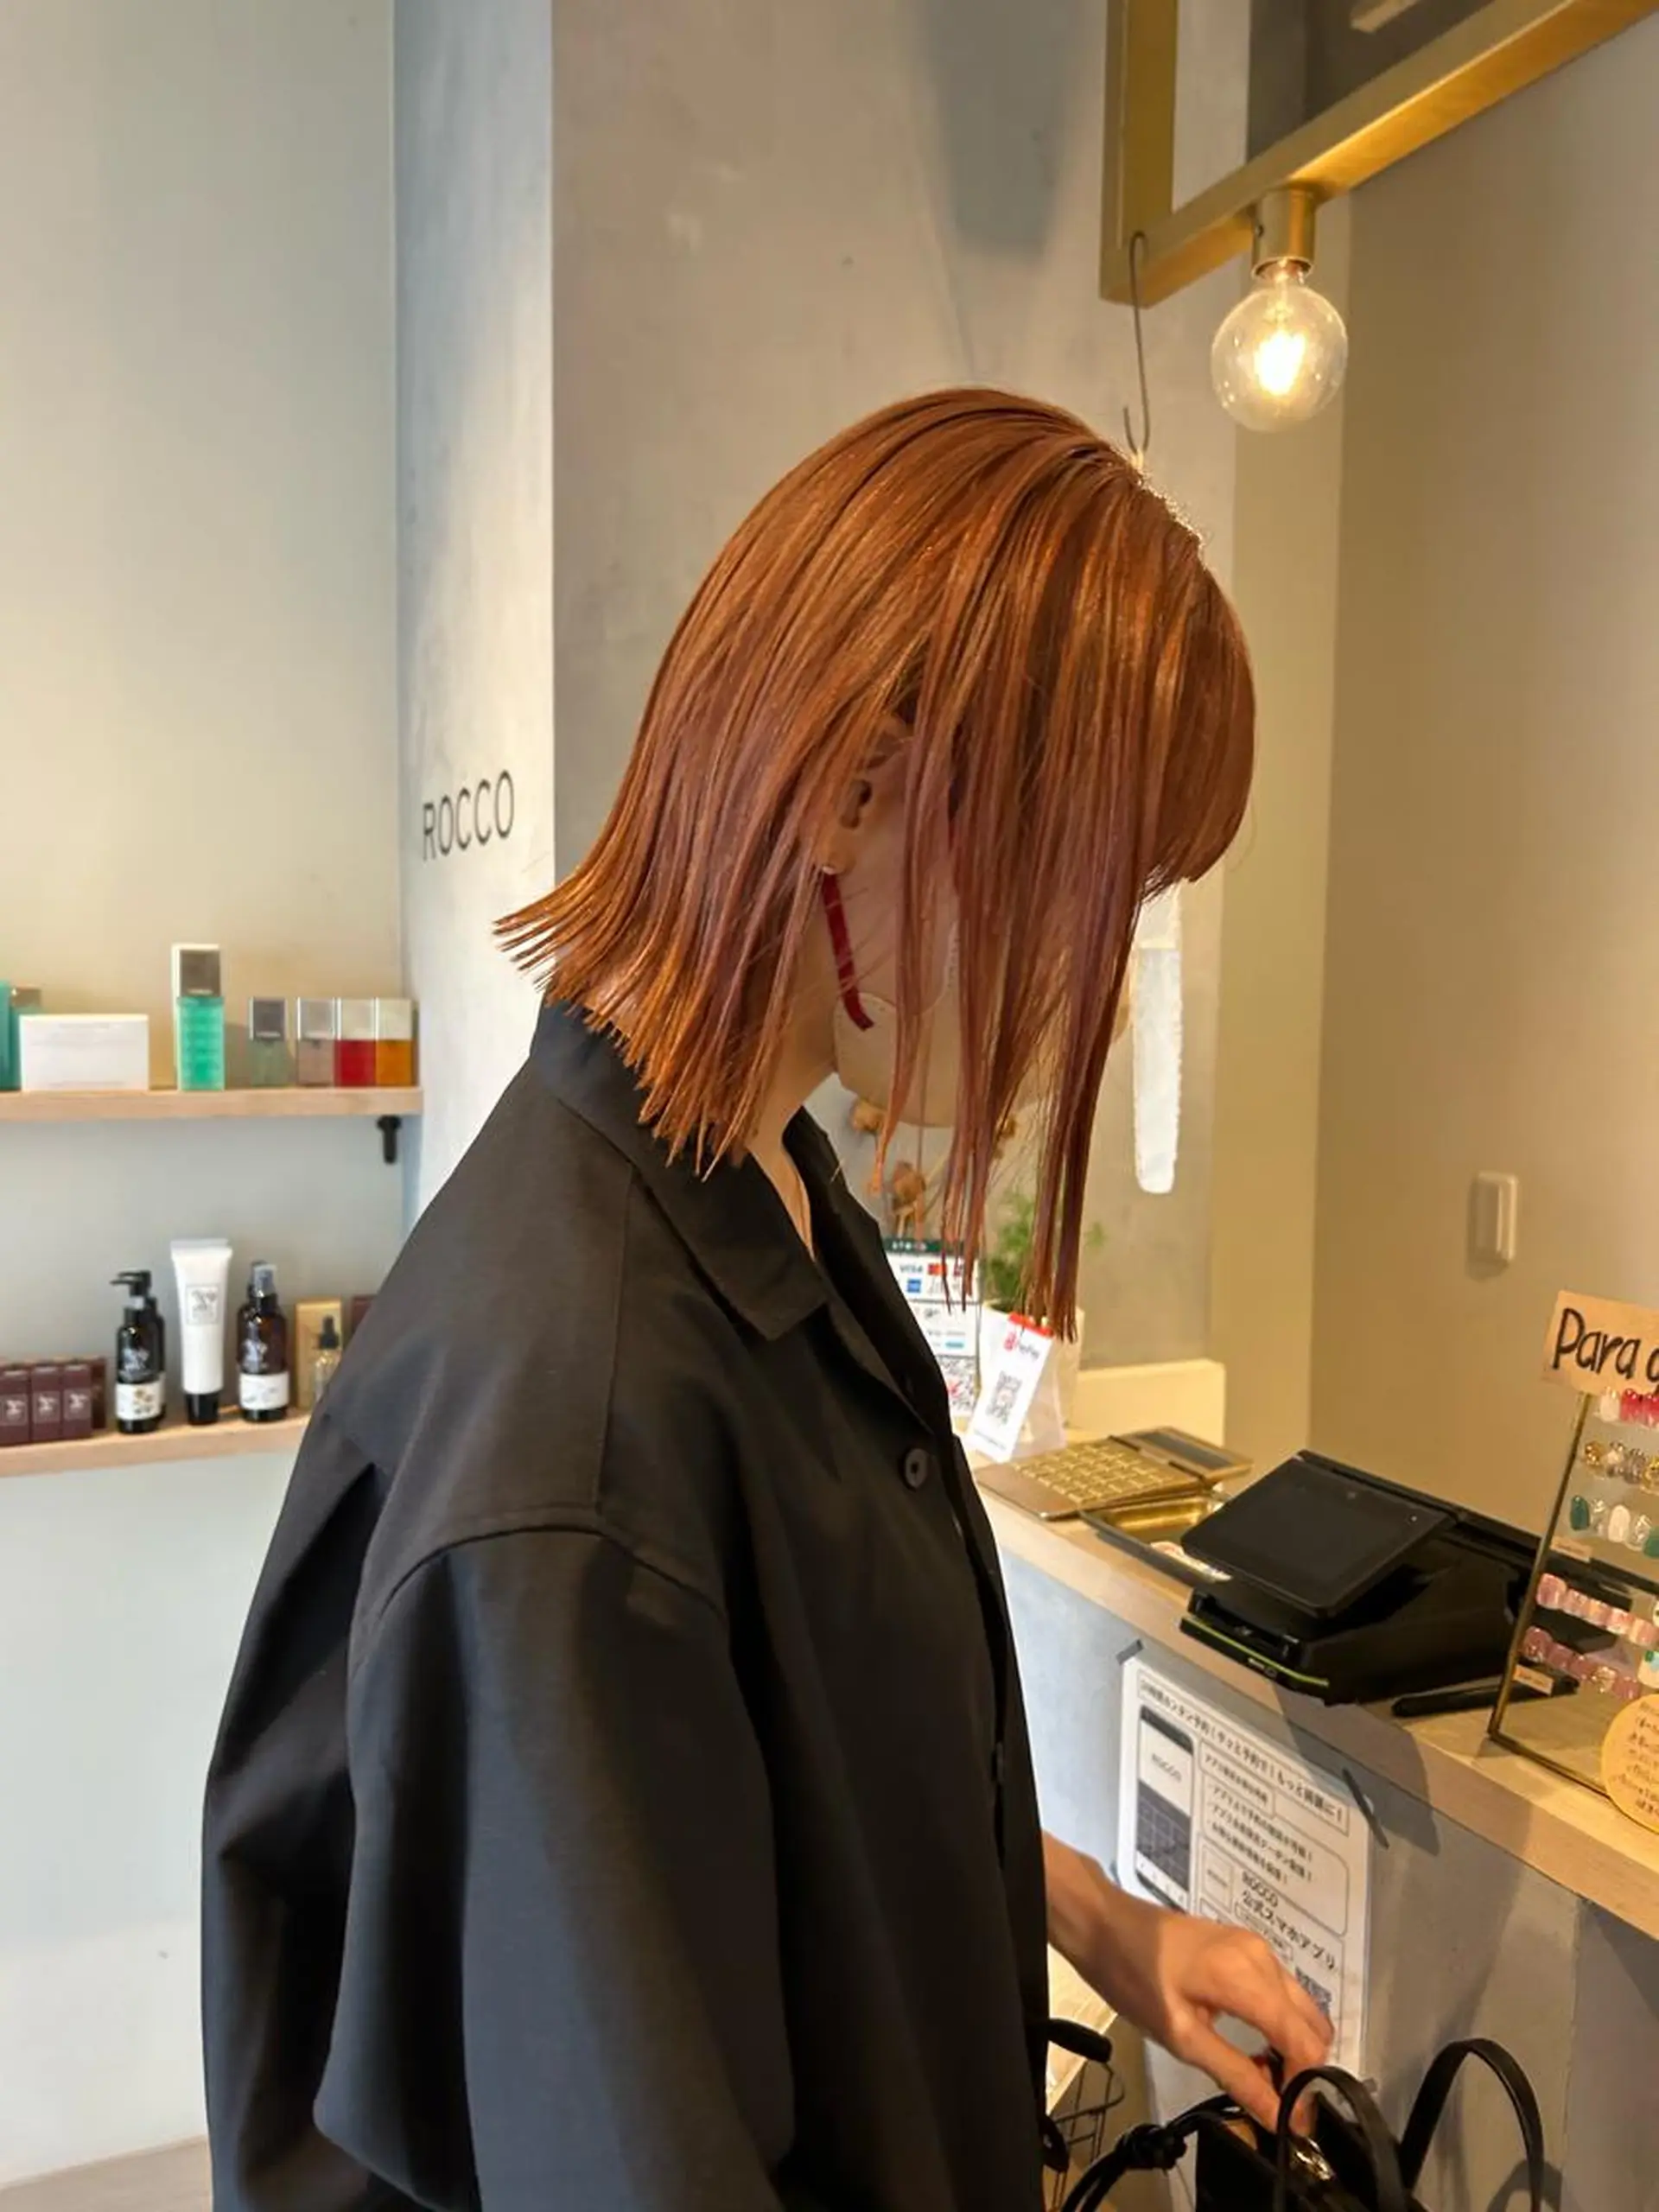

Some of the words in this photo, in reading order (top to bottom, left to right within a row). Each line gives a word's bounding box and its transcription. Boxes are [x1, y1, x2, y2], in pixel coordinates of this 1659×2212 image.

[423, 769, 515, 861] ROCCO
[1553, 1306, 1641, 1380] Para
[1242, 1890, 1337, 1971] 公式スマホアプリ
